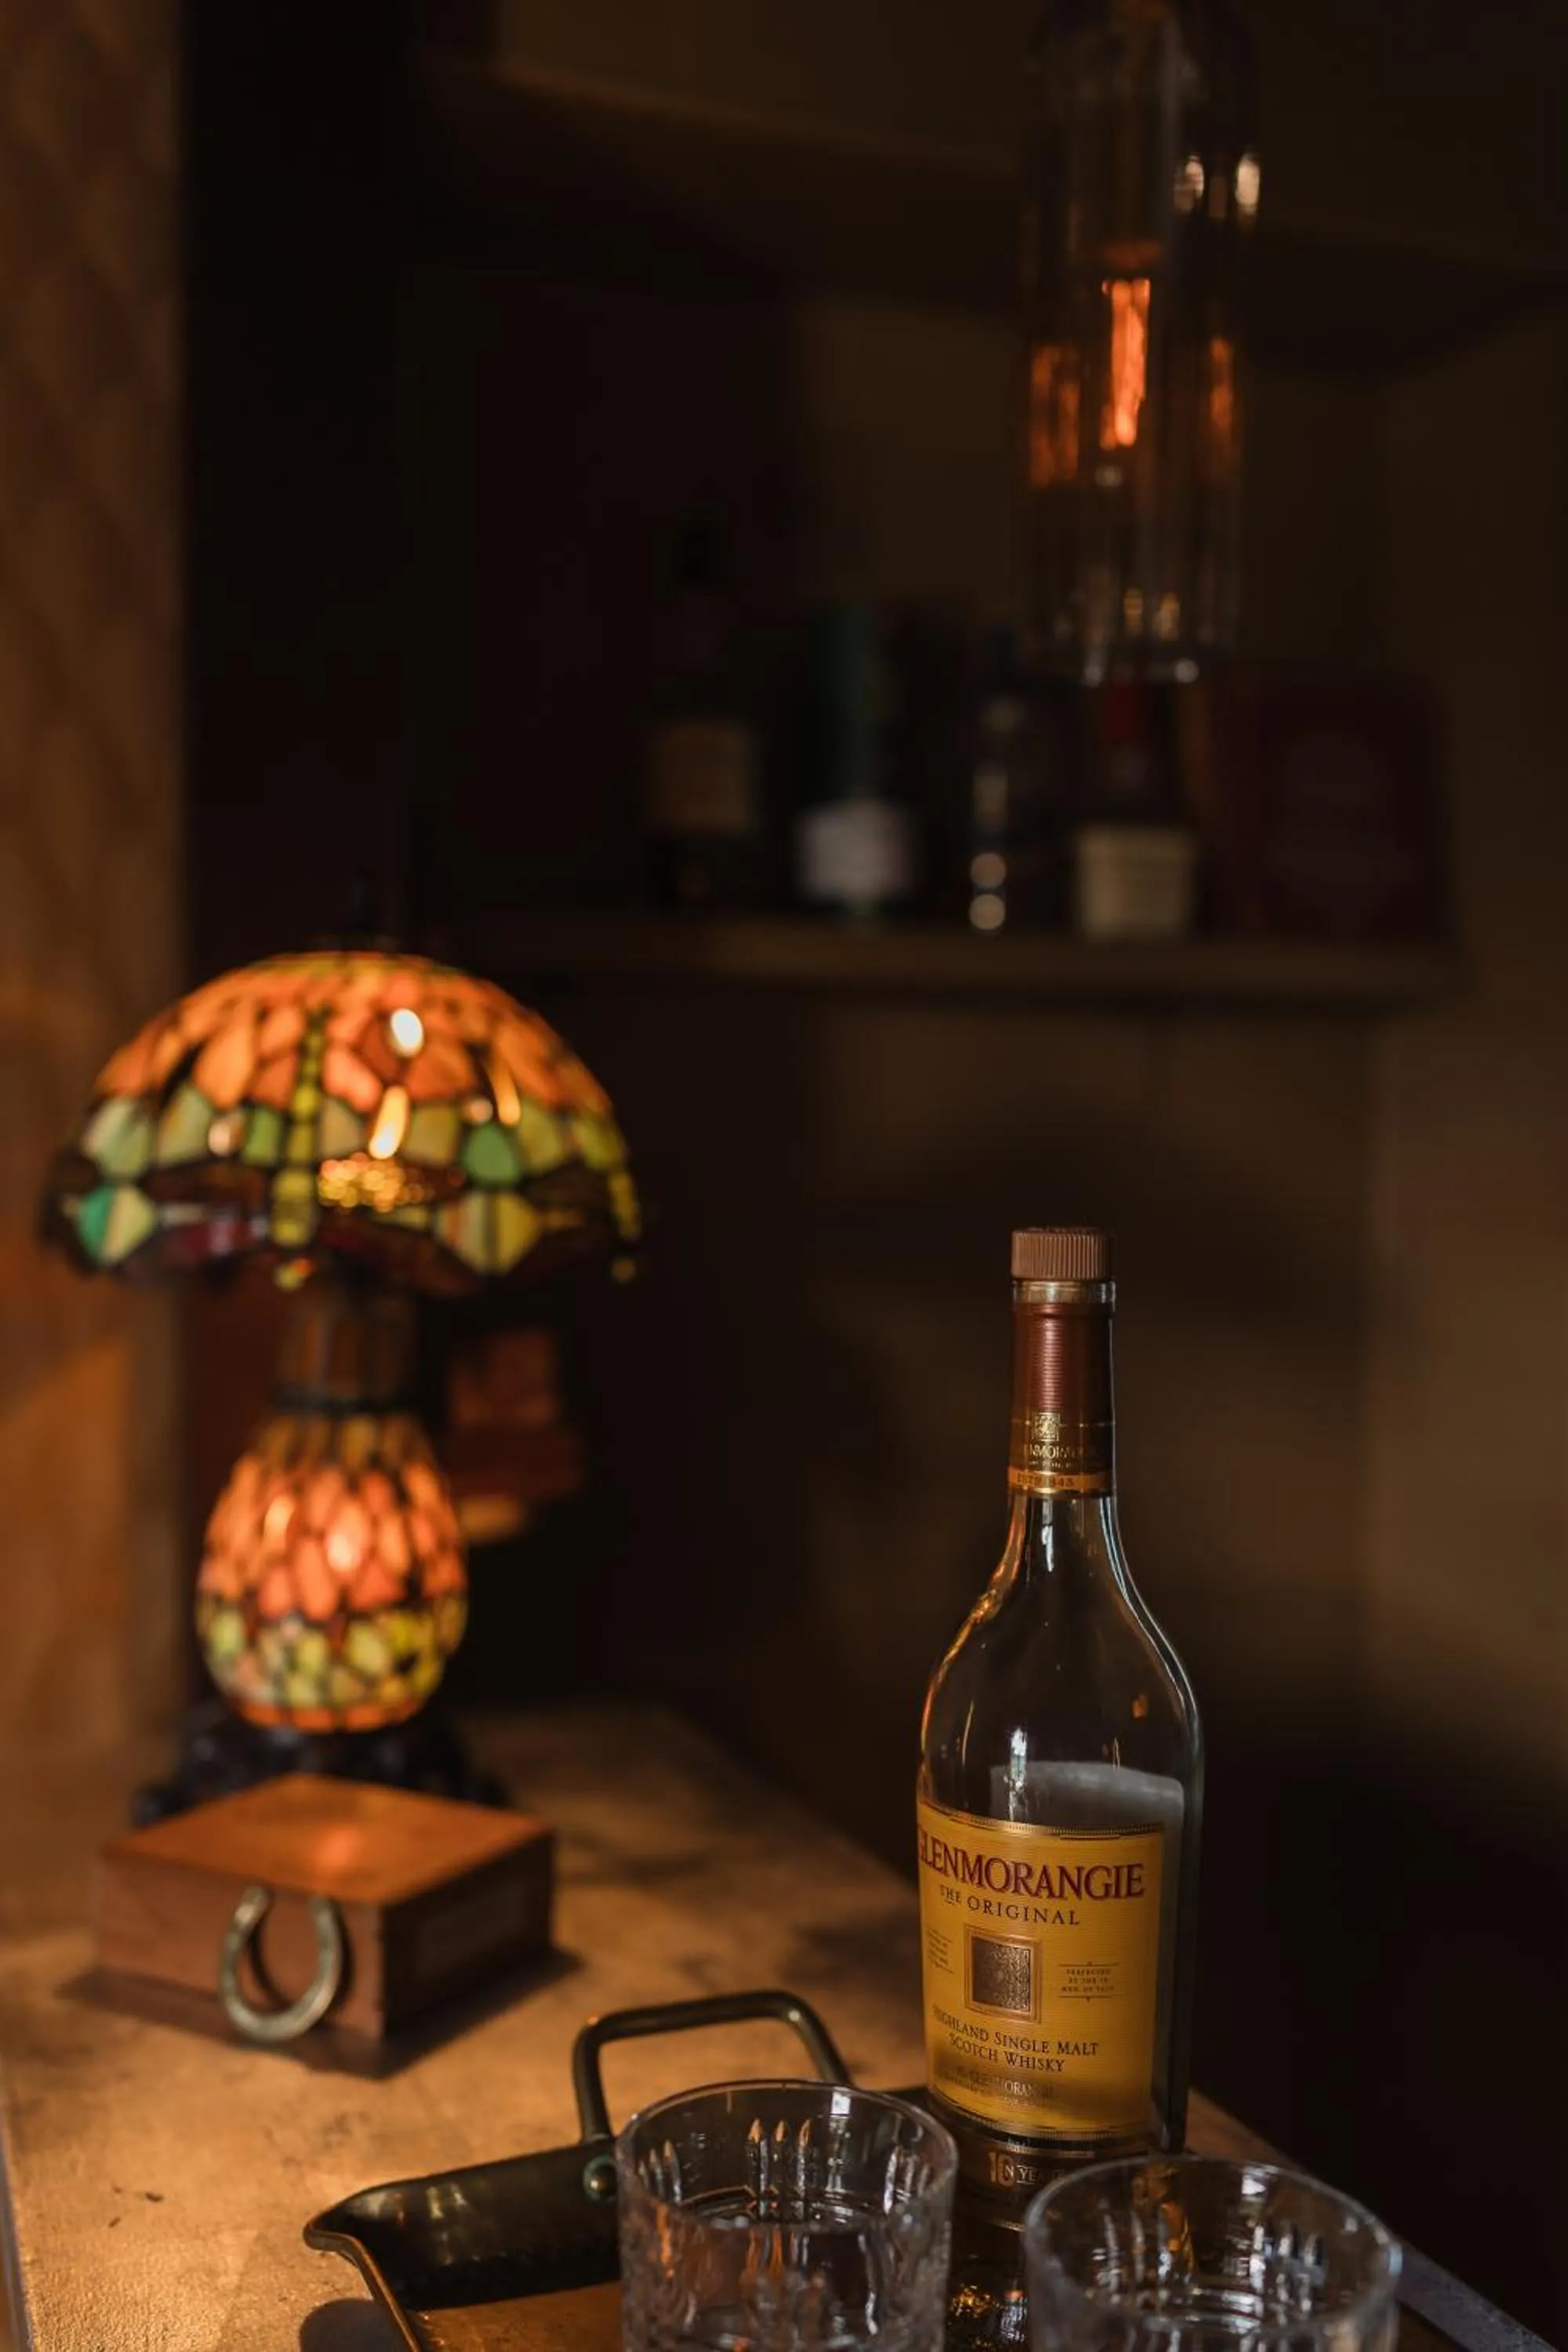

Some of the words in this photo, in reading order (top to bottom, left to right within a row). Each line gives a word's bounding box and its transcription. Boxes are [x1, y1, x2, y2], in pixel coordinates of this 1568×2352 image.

[939, 1884, 961, 1904] THE
[967, 1895, 1080, 1926] ORIGINAL
[948, 2032, 998, 2063] SCOTCH
[1004, 2050, 1065, 2073] WHISKY
[994, 2031, 1050, 2054] SINGLE
[1057, 2040, 1099, 2056] MALT
